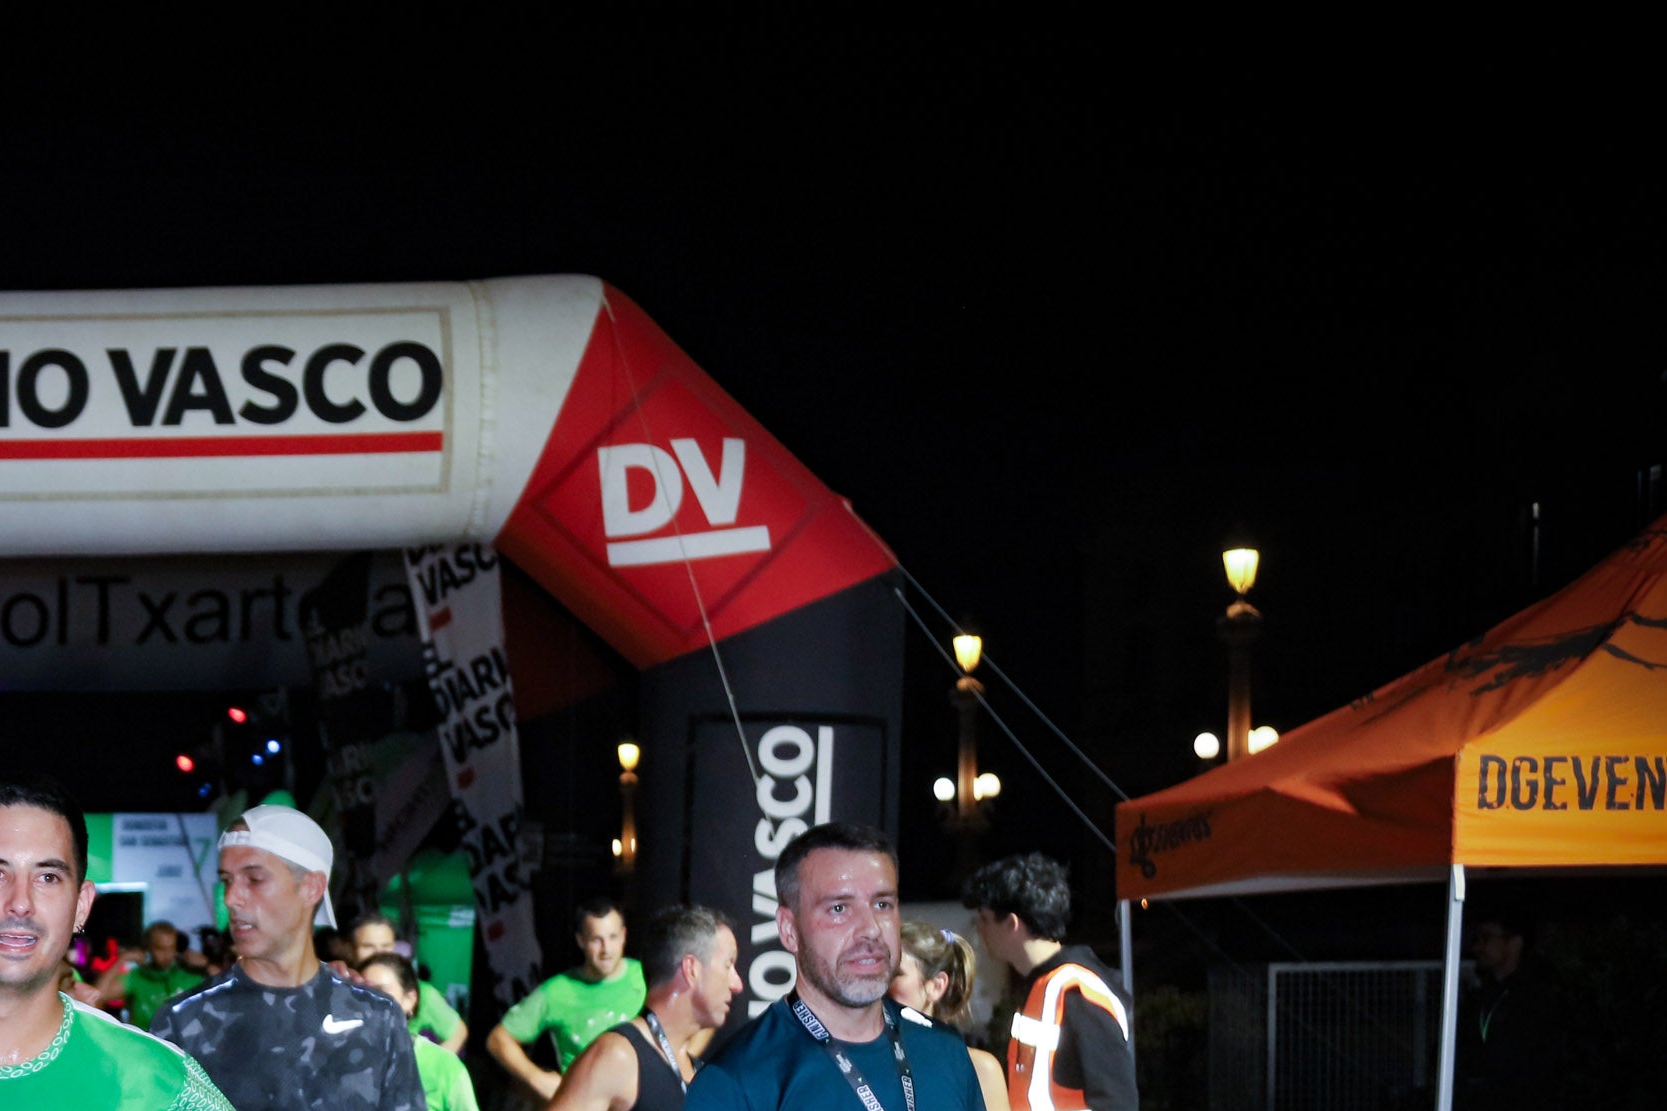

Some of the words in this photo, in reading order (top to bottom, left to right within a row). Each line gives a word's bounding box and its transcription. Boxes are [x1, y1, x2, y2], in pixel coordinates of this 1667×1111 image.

[108, 342, 443, 427] VASCO
[598, 437, 747, 539] DV
[1478, 754, 1667, 811] DGEVEN
[793, 1000, 830, 1042] FINISHER
